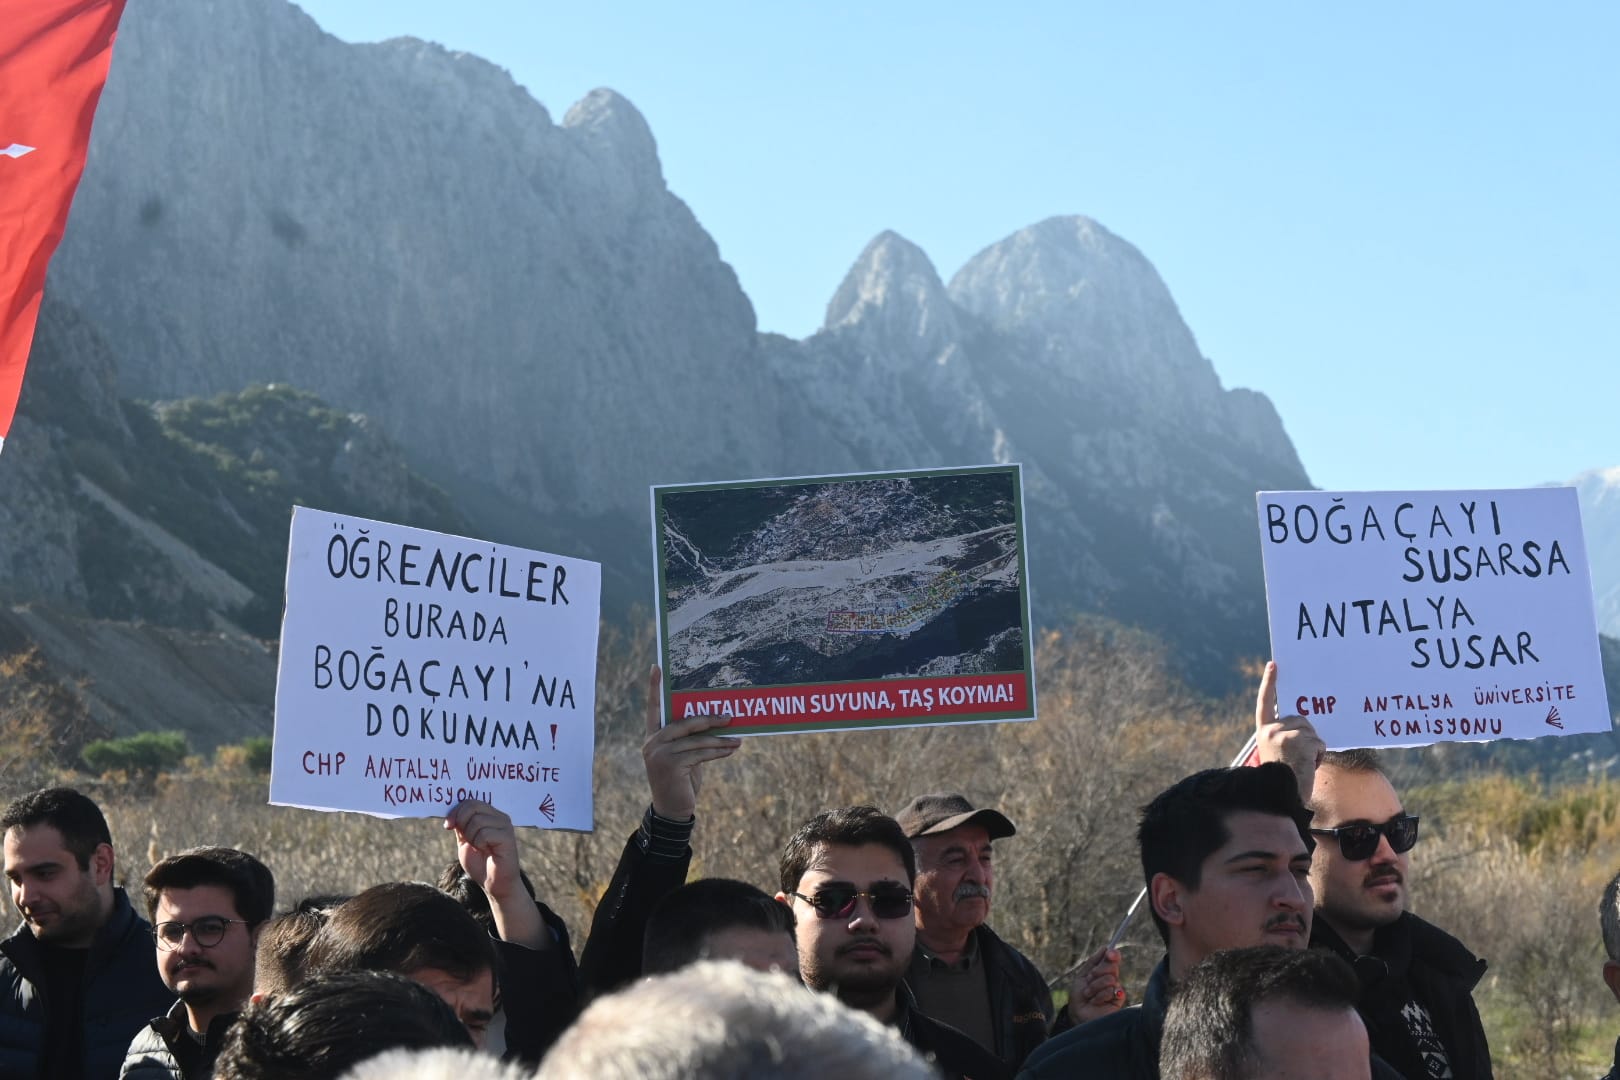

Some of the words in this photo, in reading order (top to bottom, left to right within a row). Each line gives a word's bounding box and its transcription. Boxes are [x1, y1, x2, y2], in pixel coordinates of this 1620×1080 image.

[1266, 497, 1501, 544] BOĞAÇAYI
[327, 522, 569, 605] ÖĞRENCİLER
[1402, 540, 1571, 583] SUSARSA
[384, 598, 508, 645] BURADA
[1297, 595, 1475, 641] ANTALYA
[1410, 631, 1540, 669] SUSAR
[314, 644, 576, 709] BOĞAÇAYI'NA
[1296, 695, 1337, 717] CHP
[1363, 693, 1454, 713] ANTALYA
[1474, 680, 1577, 706] ÜNİVERSİTE
[683, 695, 806, 718] ANTALYA'NIN
[810, 689, 896, 712] SUYUNA,
[898, 687, 934, 712] TAŞ
[938, 683, 1014, 705] KOYMA!
[366, 702, 558, 751] DOKUNMA!
[1374, 713, 1503, 738] KOMİSYONU
[302, 750, 346, 776] CHP
[365, 755, 451, 780] ANTALYA
[467, 756, 560, 782] ÜNİVERSİTE
